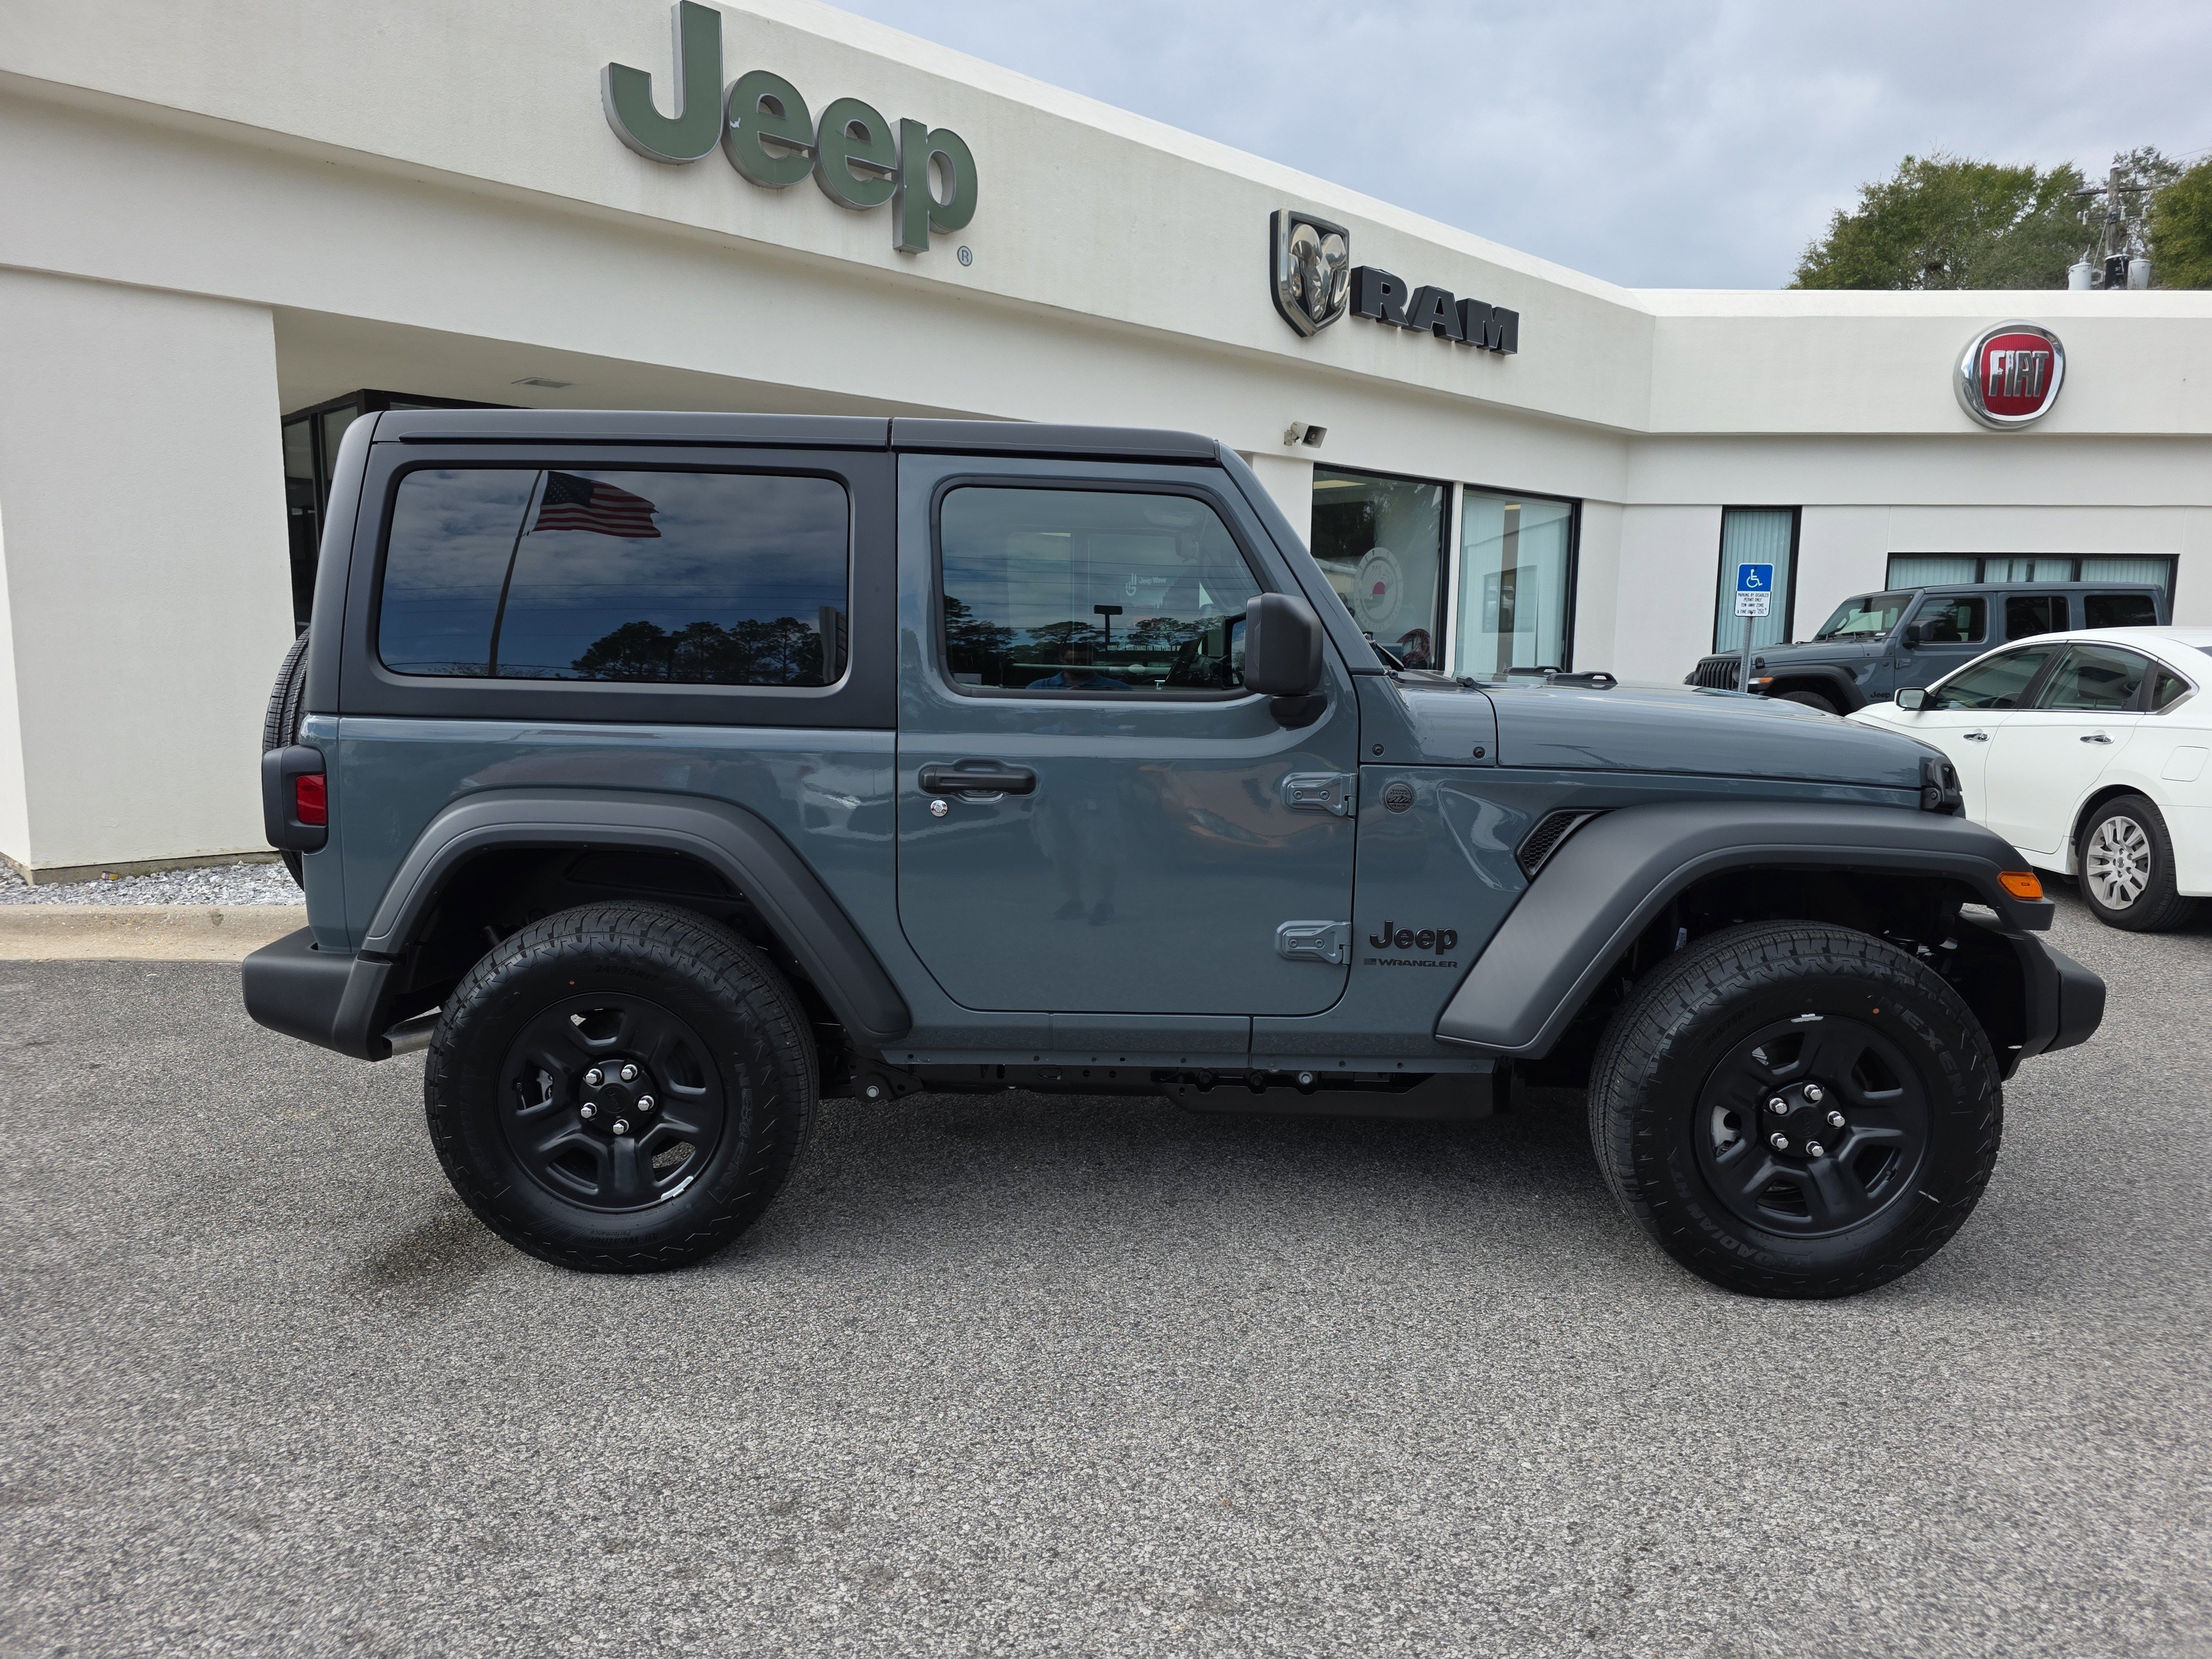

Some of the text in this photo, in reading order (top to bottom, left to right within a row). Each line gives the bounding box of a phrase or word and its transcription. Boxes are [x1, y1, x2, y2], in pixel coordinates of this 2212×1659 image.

[601, 0, 978, 254] Jeep
[1349, 265, 1519, 355] RAM
[1988, 350, 2049, 397] FIAT
[1139, 577, 1152, 585] Jeep
[1369, 920, 1458, 955] Jeep
[1377, 958, 1458, 968] WRANGLER
